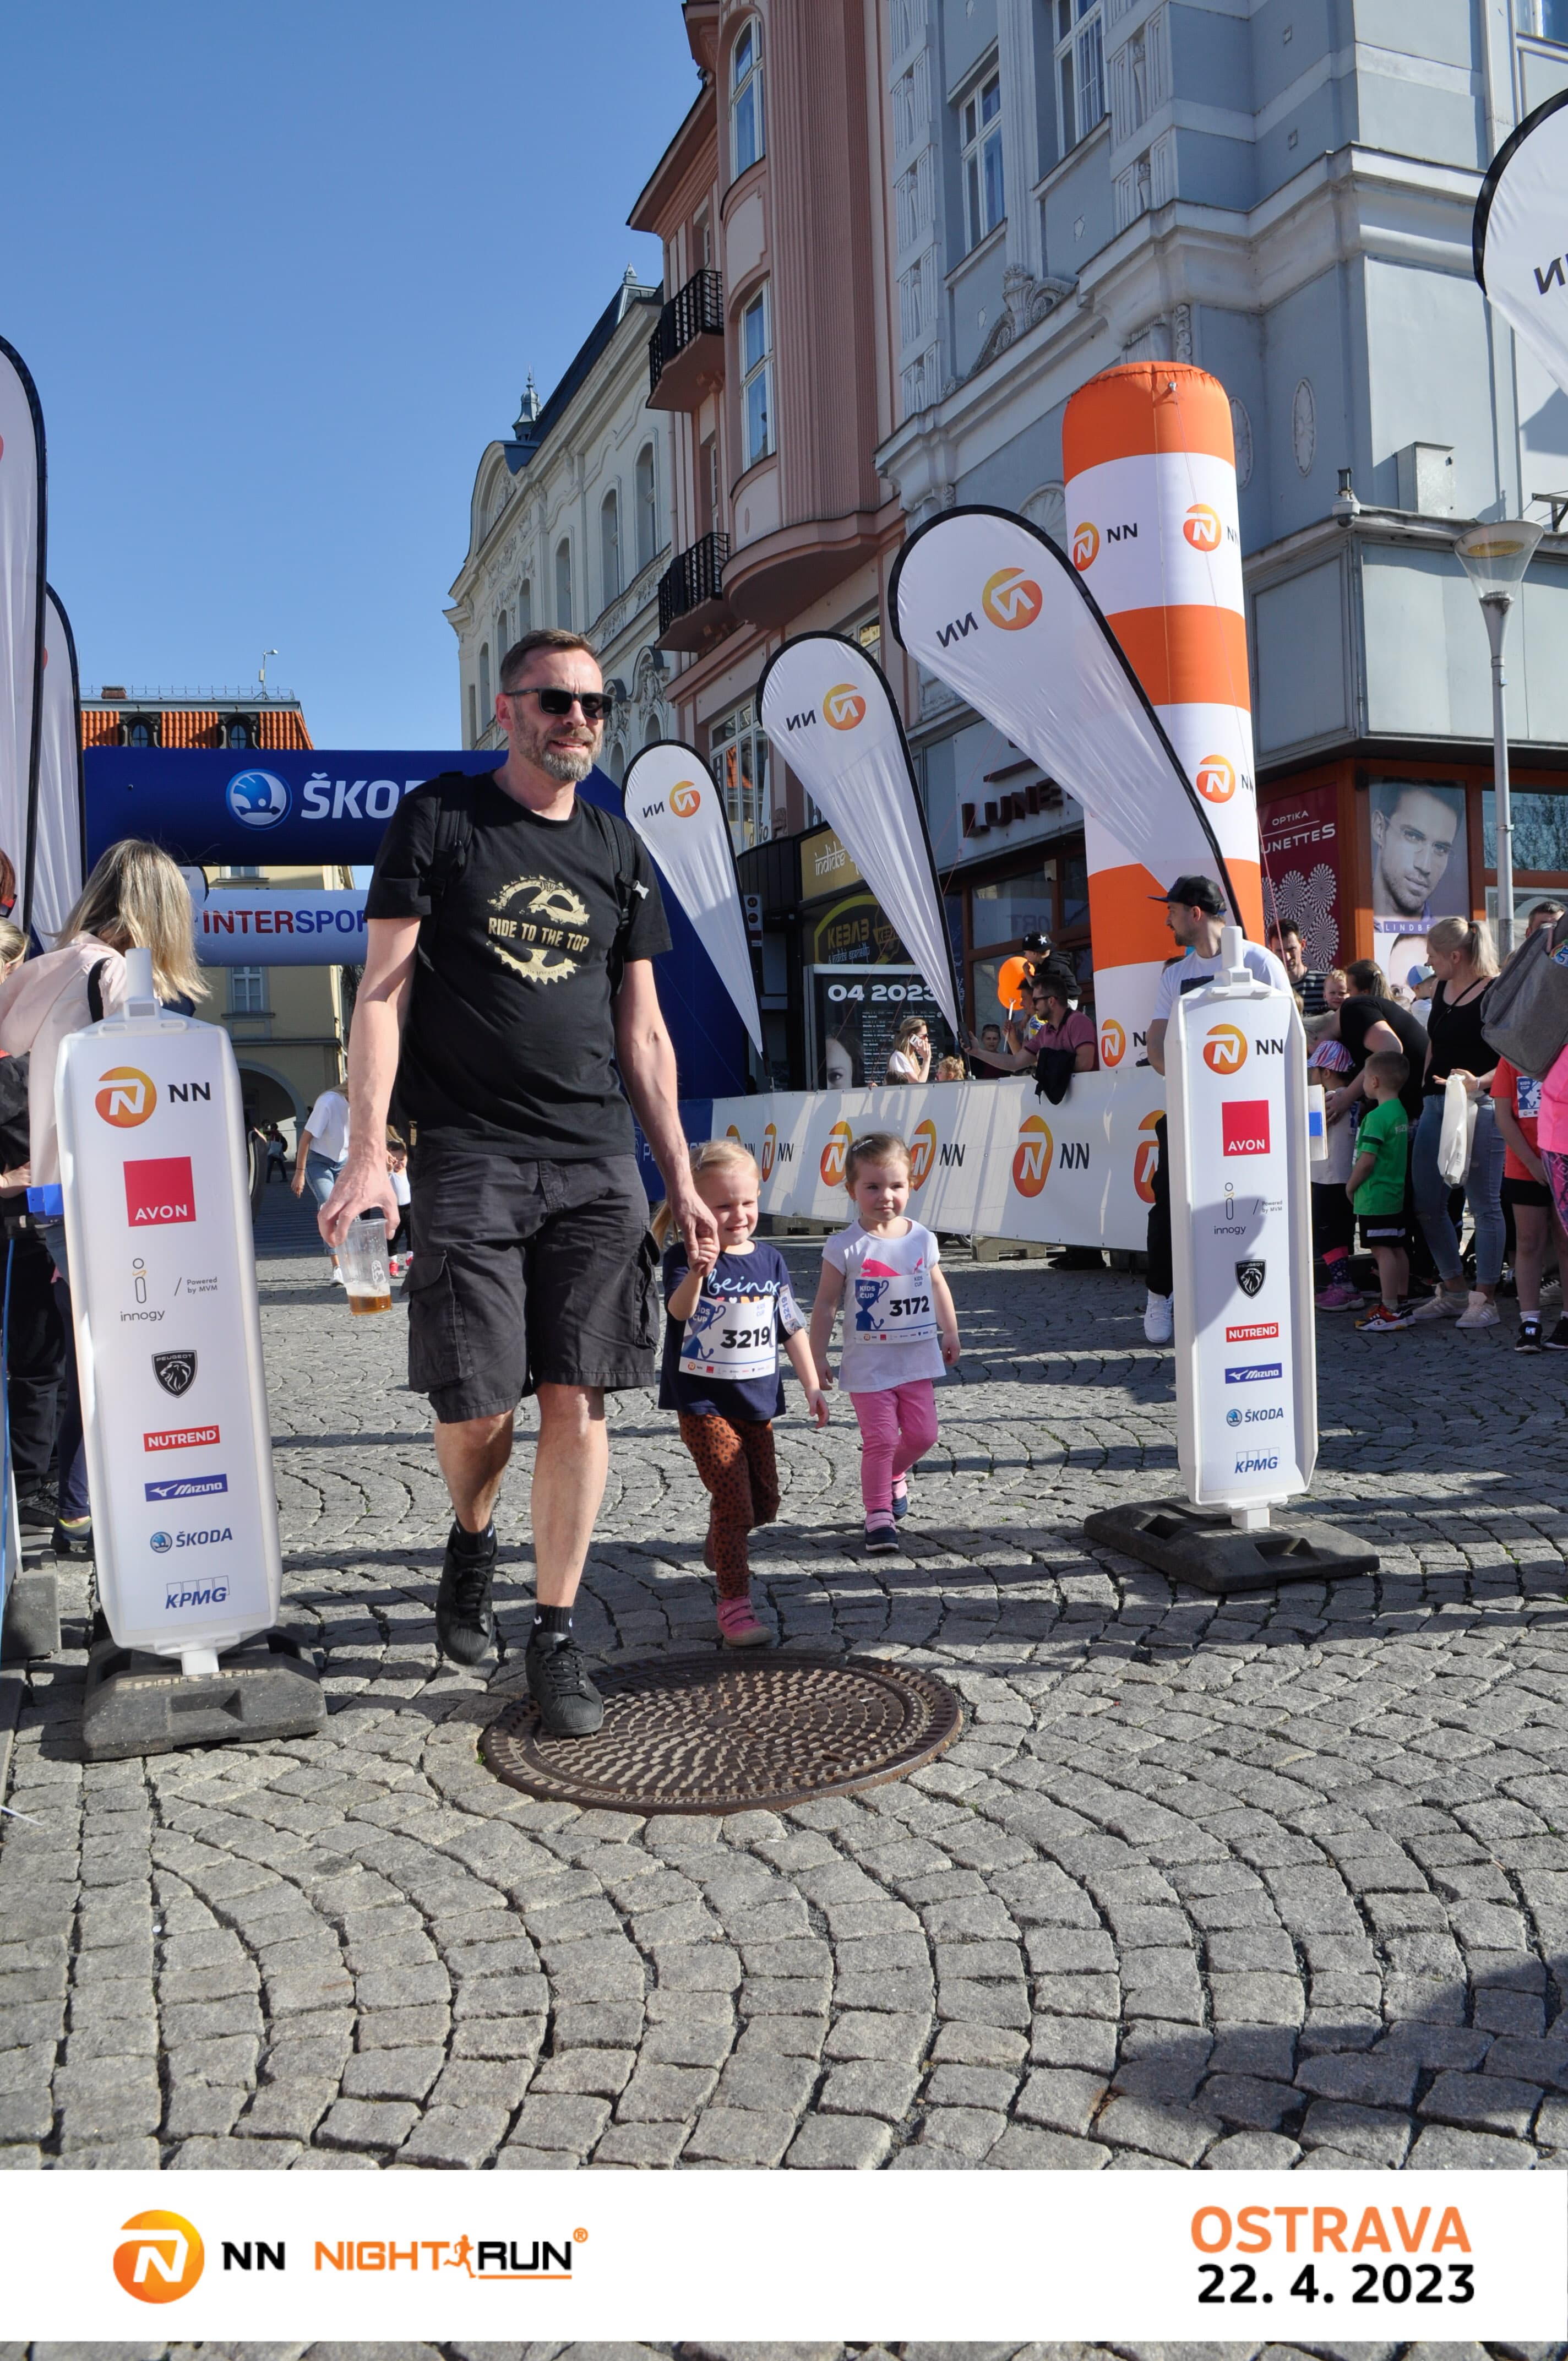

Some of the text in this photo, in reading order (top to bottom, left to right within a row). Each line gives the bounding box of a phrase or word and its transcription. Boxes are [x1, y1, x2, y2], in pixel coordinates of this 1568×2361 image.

[1107, 523, 1137, 543] NN
[962, 777, 1074, 838] LUNE
[1272, 810, 1308, 825] OPTIKA
[1261, 823, 1335, 854] UNETTES
[488, 917, 590, 952] RIDE TO THE TOP
[1385, 921, 1431, 931] LINDBE
[827, 984, 937, 1002] 04 2023
[1133, 1031, 1147, 1047] N
[1256, 1039, 1283, 1056] NN
[168, 1082, 211, 1102] NN
[777, 1143, 794, 1162] NN
[1228, 1139, 1265, 1151] AVON
[939, 1144, 965, 1167] NN
[1059, 1143, 1090, 1169] NN
[135, 1204, 187, 1221] AVON
[1214, 1225, 1246, 1235] innogy
[187, 1277, 217, 1286] Powered
[697, 1305, 710, 1314] IDS
[781, 1296, 792, 1320] 3219
[889, 1295, 930, 1317] 3172
[121, 1310, 165, 1322] innogy
[693, 1314, 707, 1322] CUP
[720, 1326, 770, 1348] 3219
[1229, 1325, 1277, 1339] NUTREND
[156, 1353, 193, 1362] PEUGEOT
[1244, 1407, 1283, 1422] ŠKODA
[148, 1430, 216, 1447] NUTREND
[1235, 1456, 1278, 1473] KPMG
[176, 1527, 232, 1548] ŠKODA
[165, 1587, 227, 1609] KPMG
